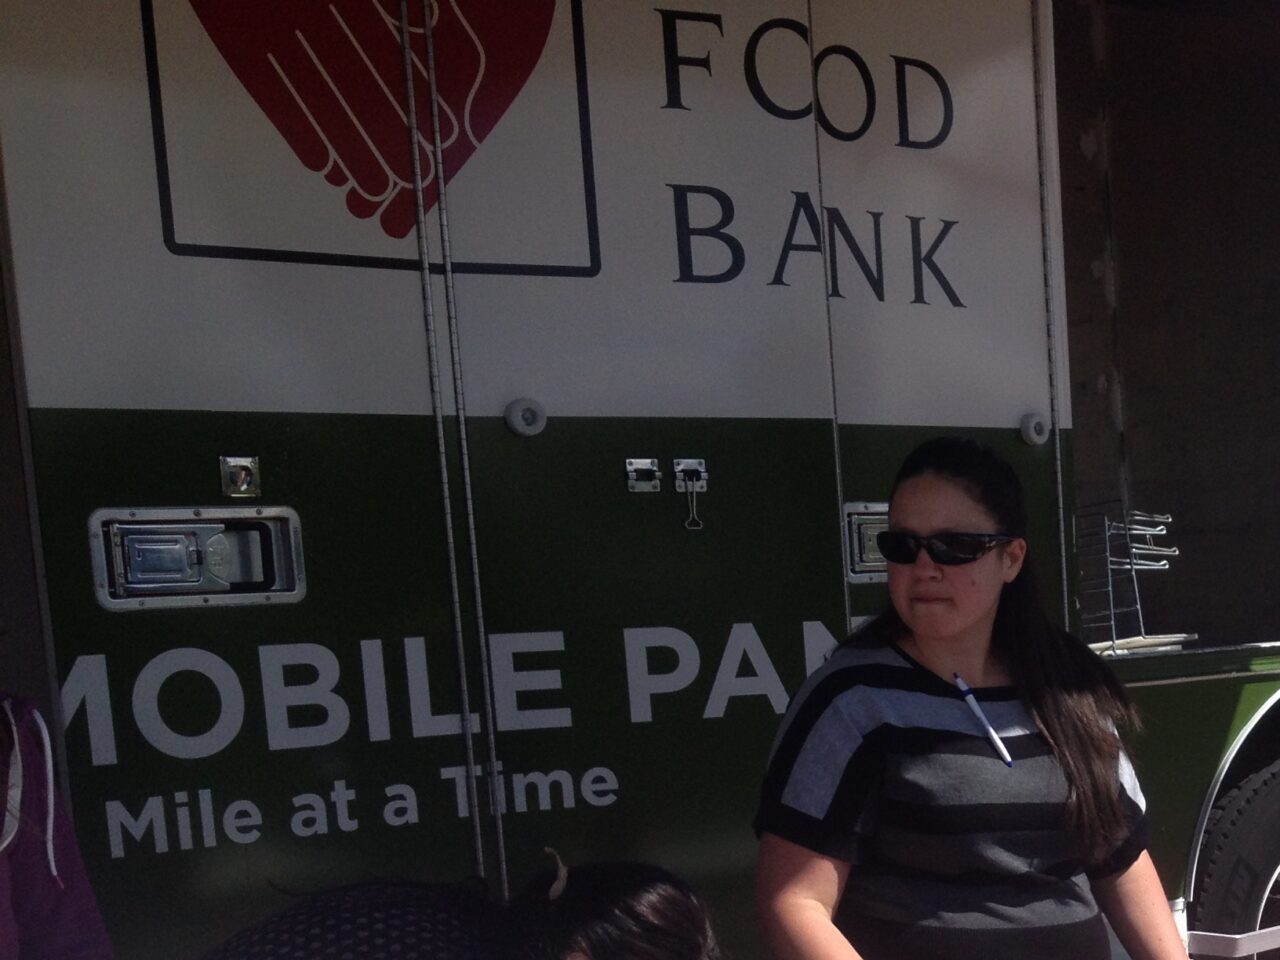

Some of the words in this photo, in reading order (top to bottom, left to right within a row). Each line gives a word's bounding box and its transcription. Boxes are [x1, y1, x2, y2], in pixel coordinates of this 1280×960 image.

[653, 8, 955, 150] FOOD
[664, 183, 967, 309] BANK
[105, 788, 263, 859] Mile
[290, 779, 359, 837] at
[383, 783, 420, 827] a
[440, 760, 620, 819] Time
